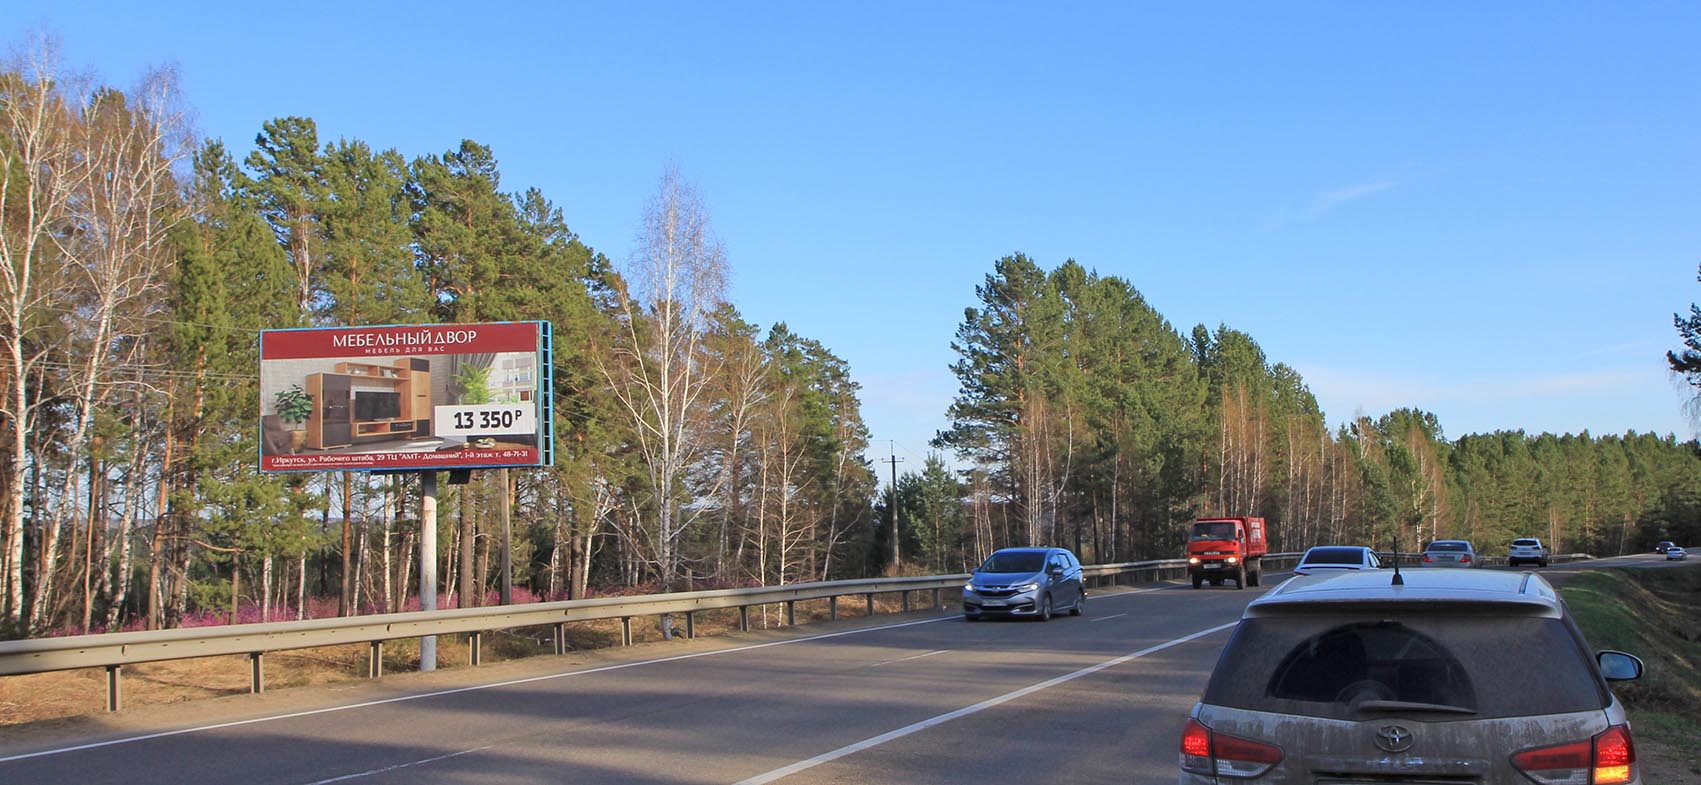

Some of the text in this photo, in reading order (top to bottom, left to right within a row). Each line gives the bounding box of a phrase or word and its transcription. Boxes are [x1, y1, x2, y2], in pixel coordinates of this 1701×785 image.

[333, 329, 477, 347] МЕБЕЛЬНЫЙ ДВОР
[454, 411, 474, 429] 13
[319, 455, 350, 463] Рабочего
